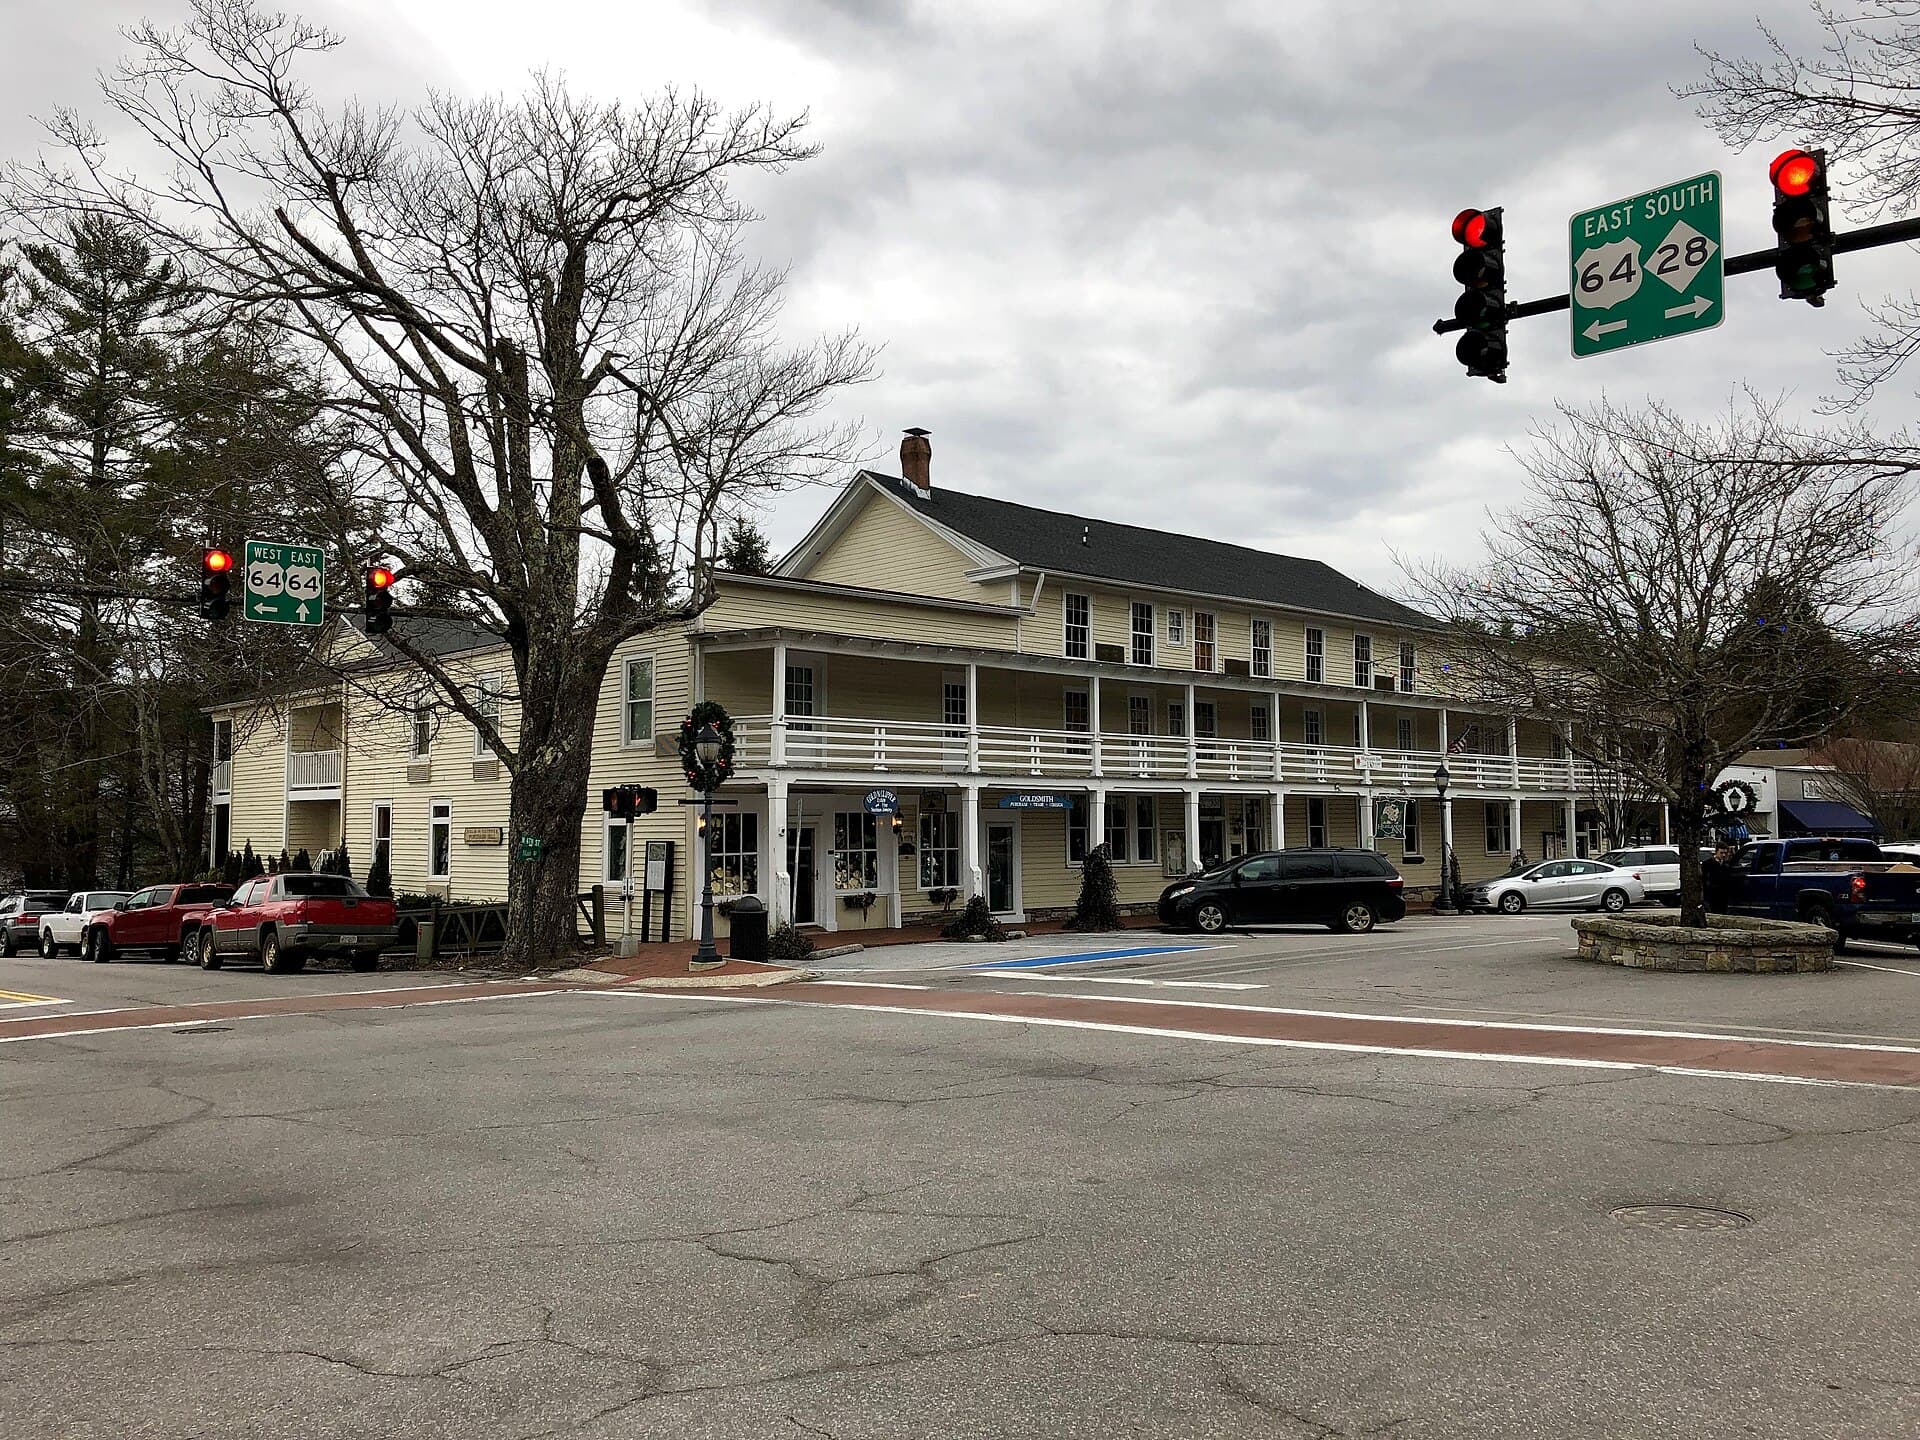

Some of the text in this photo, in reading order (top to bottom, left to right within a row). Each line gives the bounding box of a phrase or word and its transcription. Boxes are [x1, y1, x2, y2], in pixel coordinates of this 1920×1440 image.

[1584, 180, 1713, 238] EAST SOUTH
[1580, 236, 1708, 293] 64 28
[254, 547, 318, 564] WEST EAST
[250, 570, 318, 592] 64 64
[1019, 795, 1054, 803] GOLDSMITH
